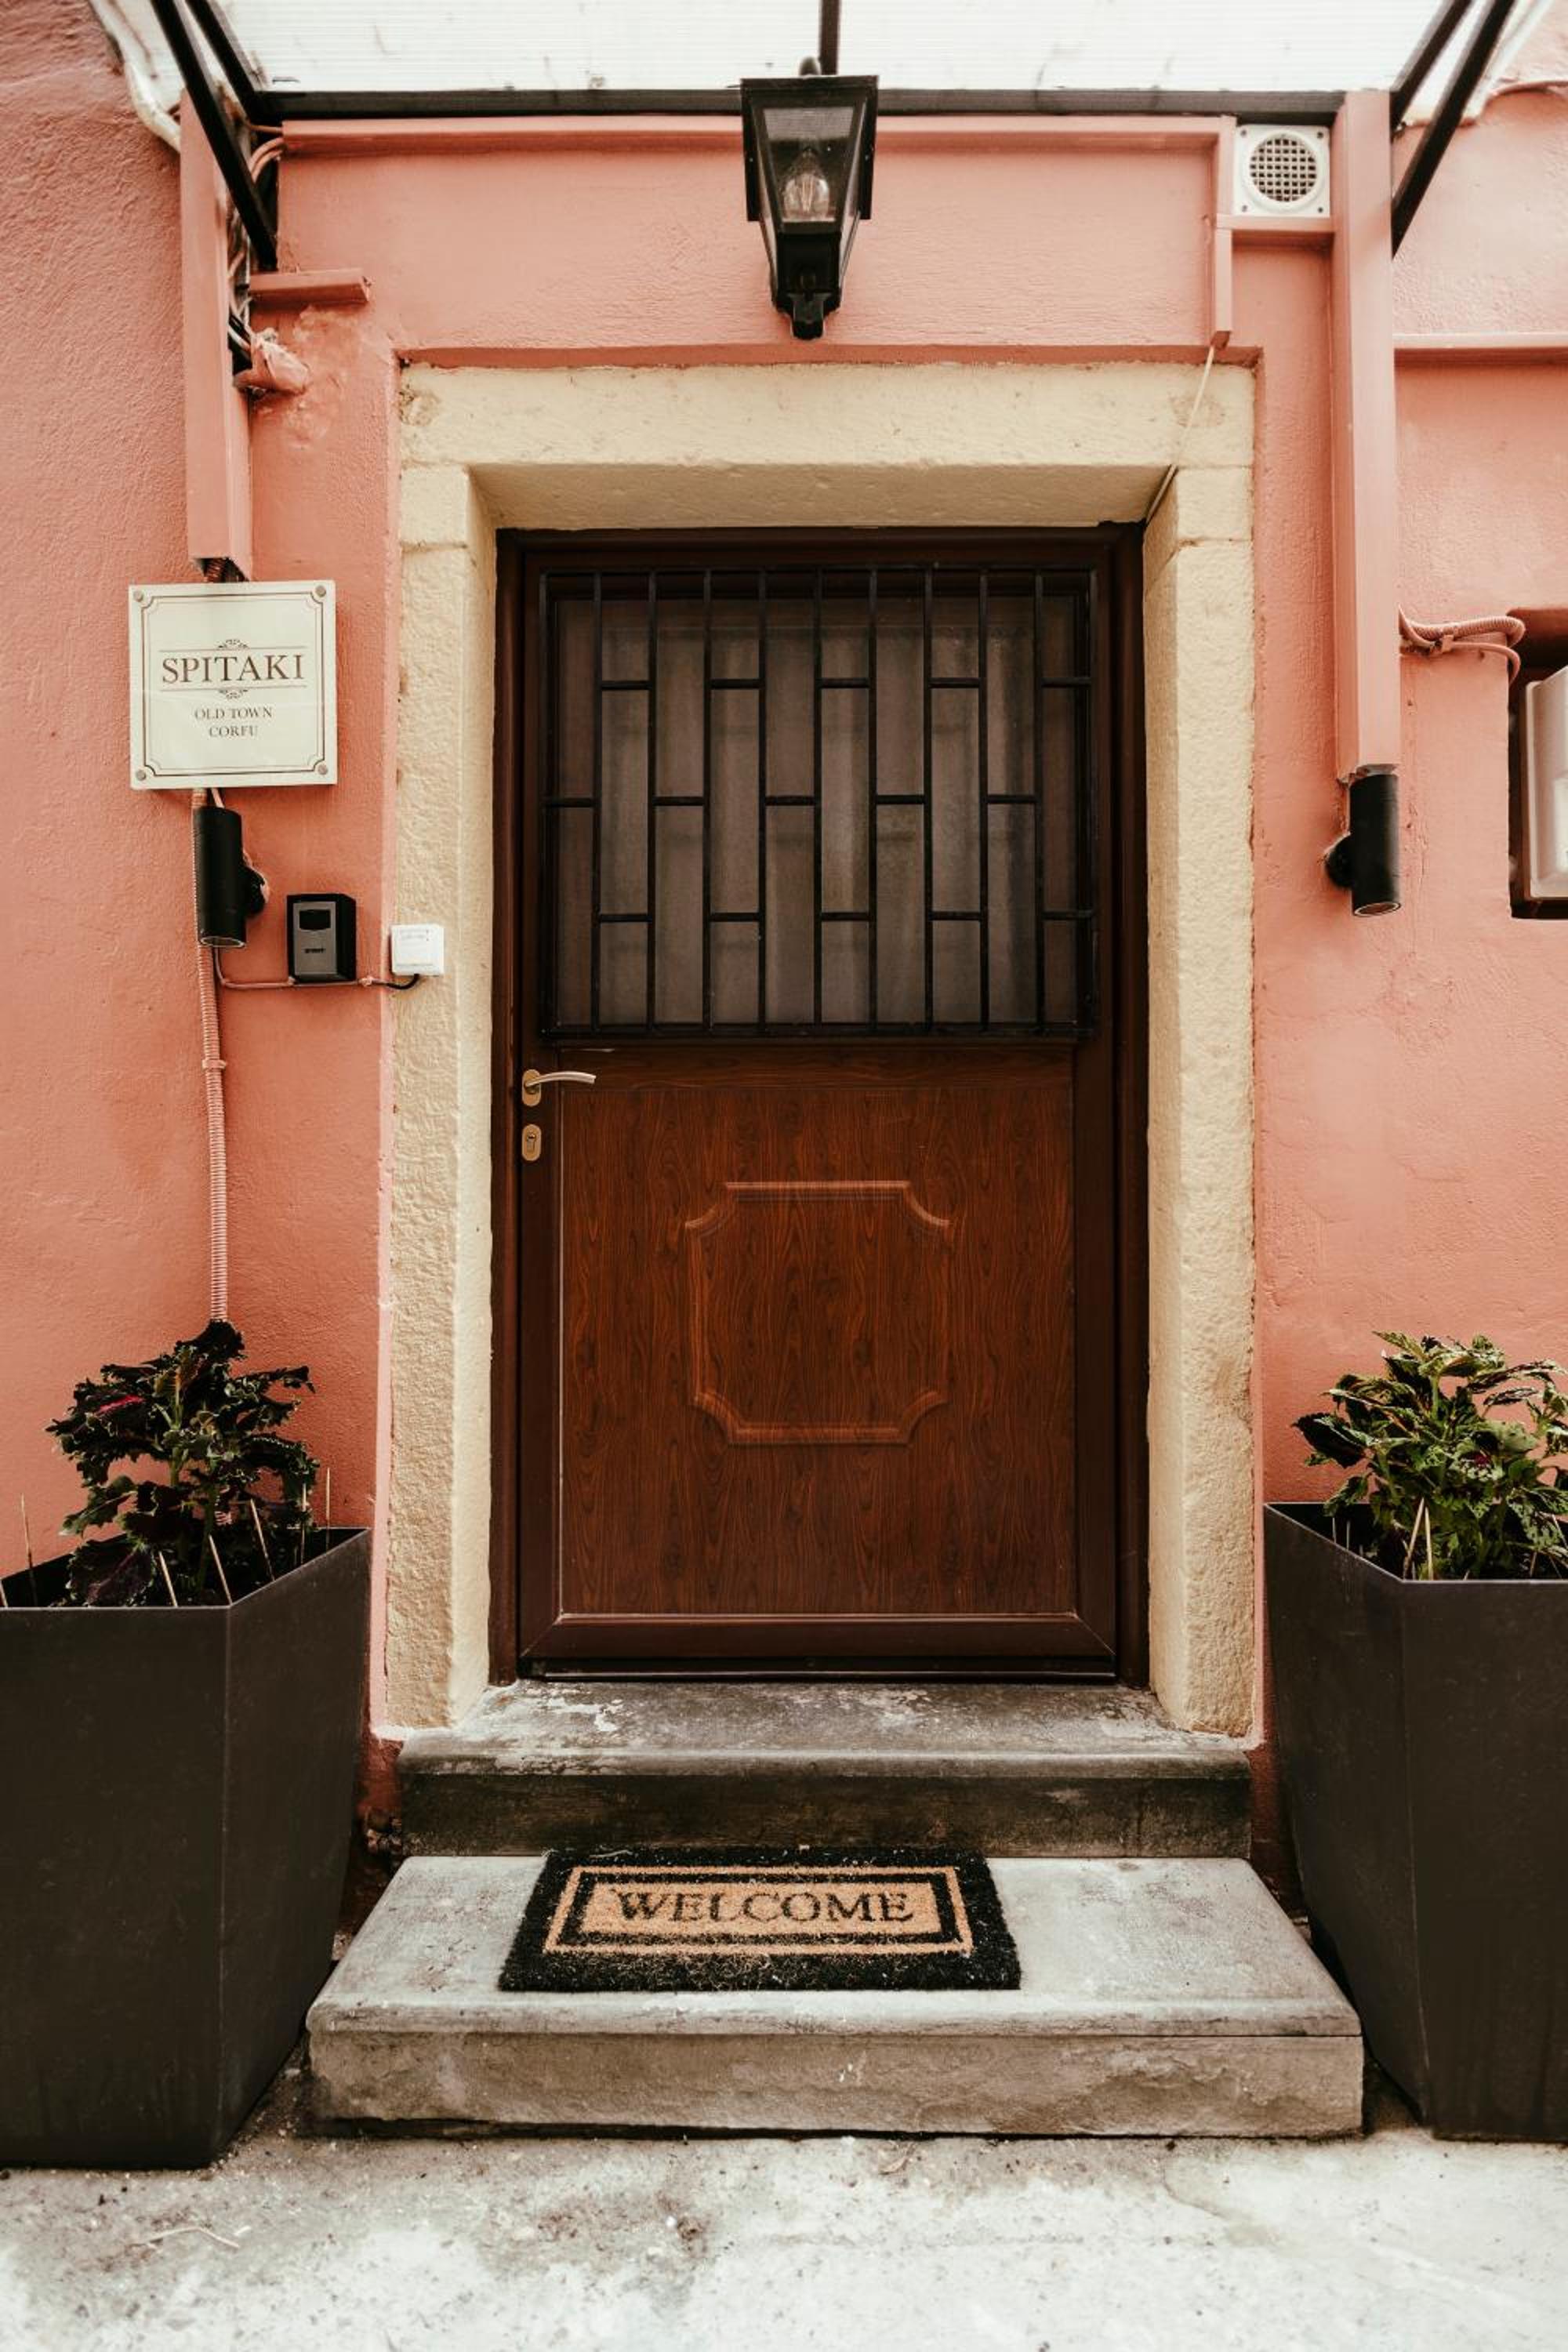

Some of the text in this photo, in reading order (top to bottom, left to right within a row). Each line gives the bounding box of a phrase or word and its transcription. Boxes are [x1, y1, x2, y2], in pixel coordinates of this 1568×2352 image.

[162, 655, 304, 684] SPITAKI
[194, 706, 273, 720] OLD TOWN
[209, 724, 259, 738] CORFU
[610, 1889, 914, 1923] WELCOME
